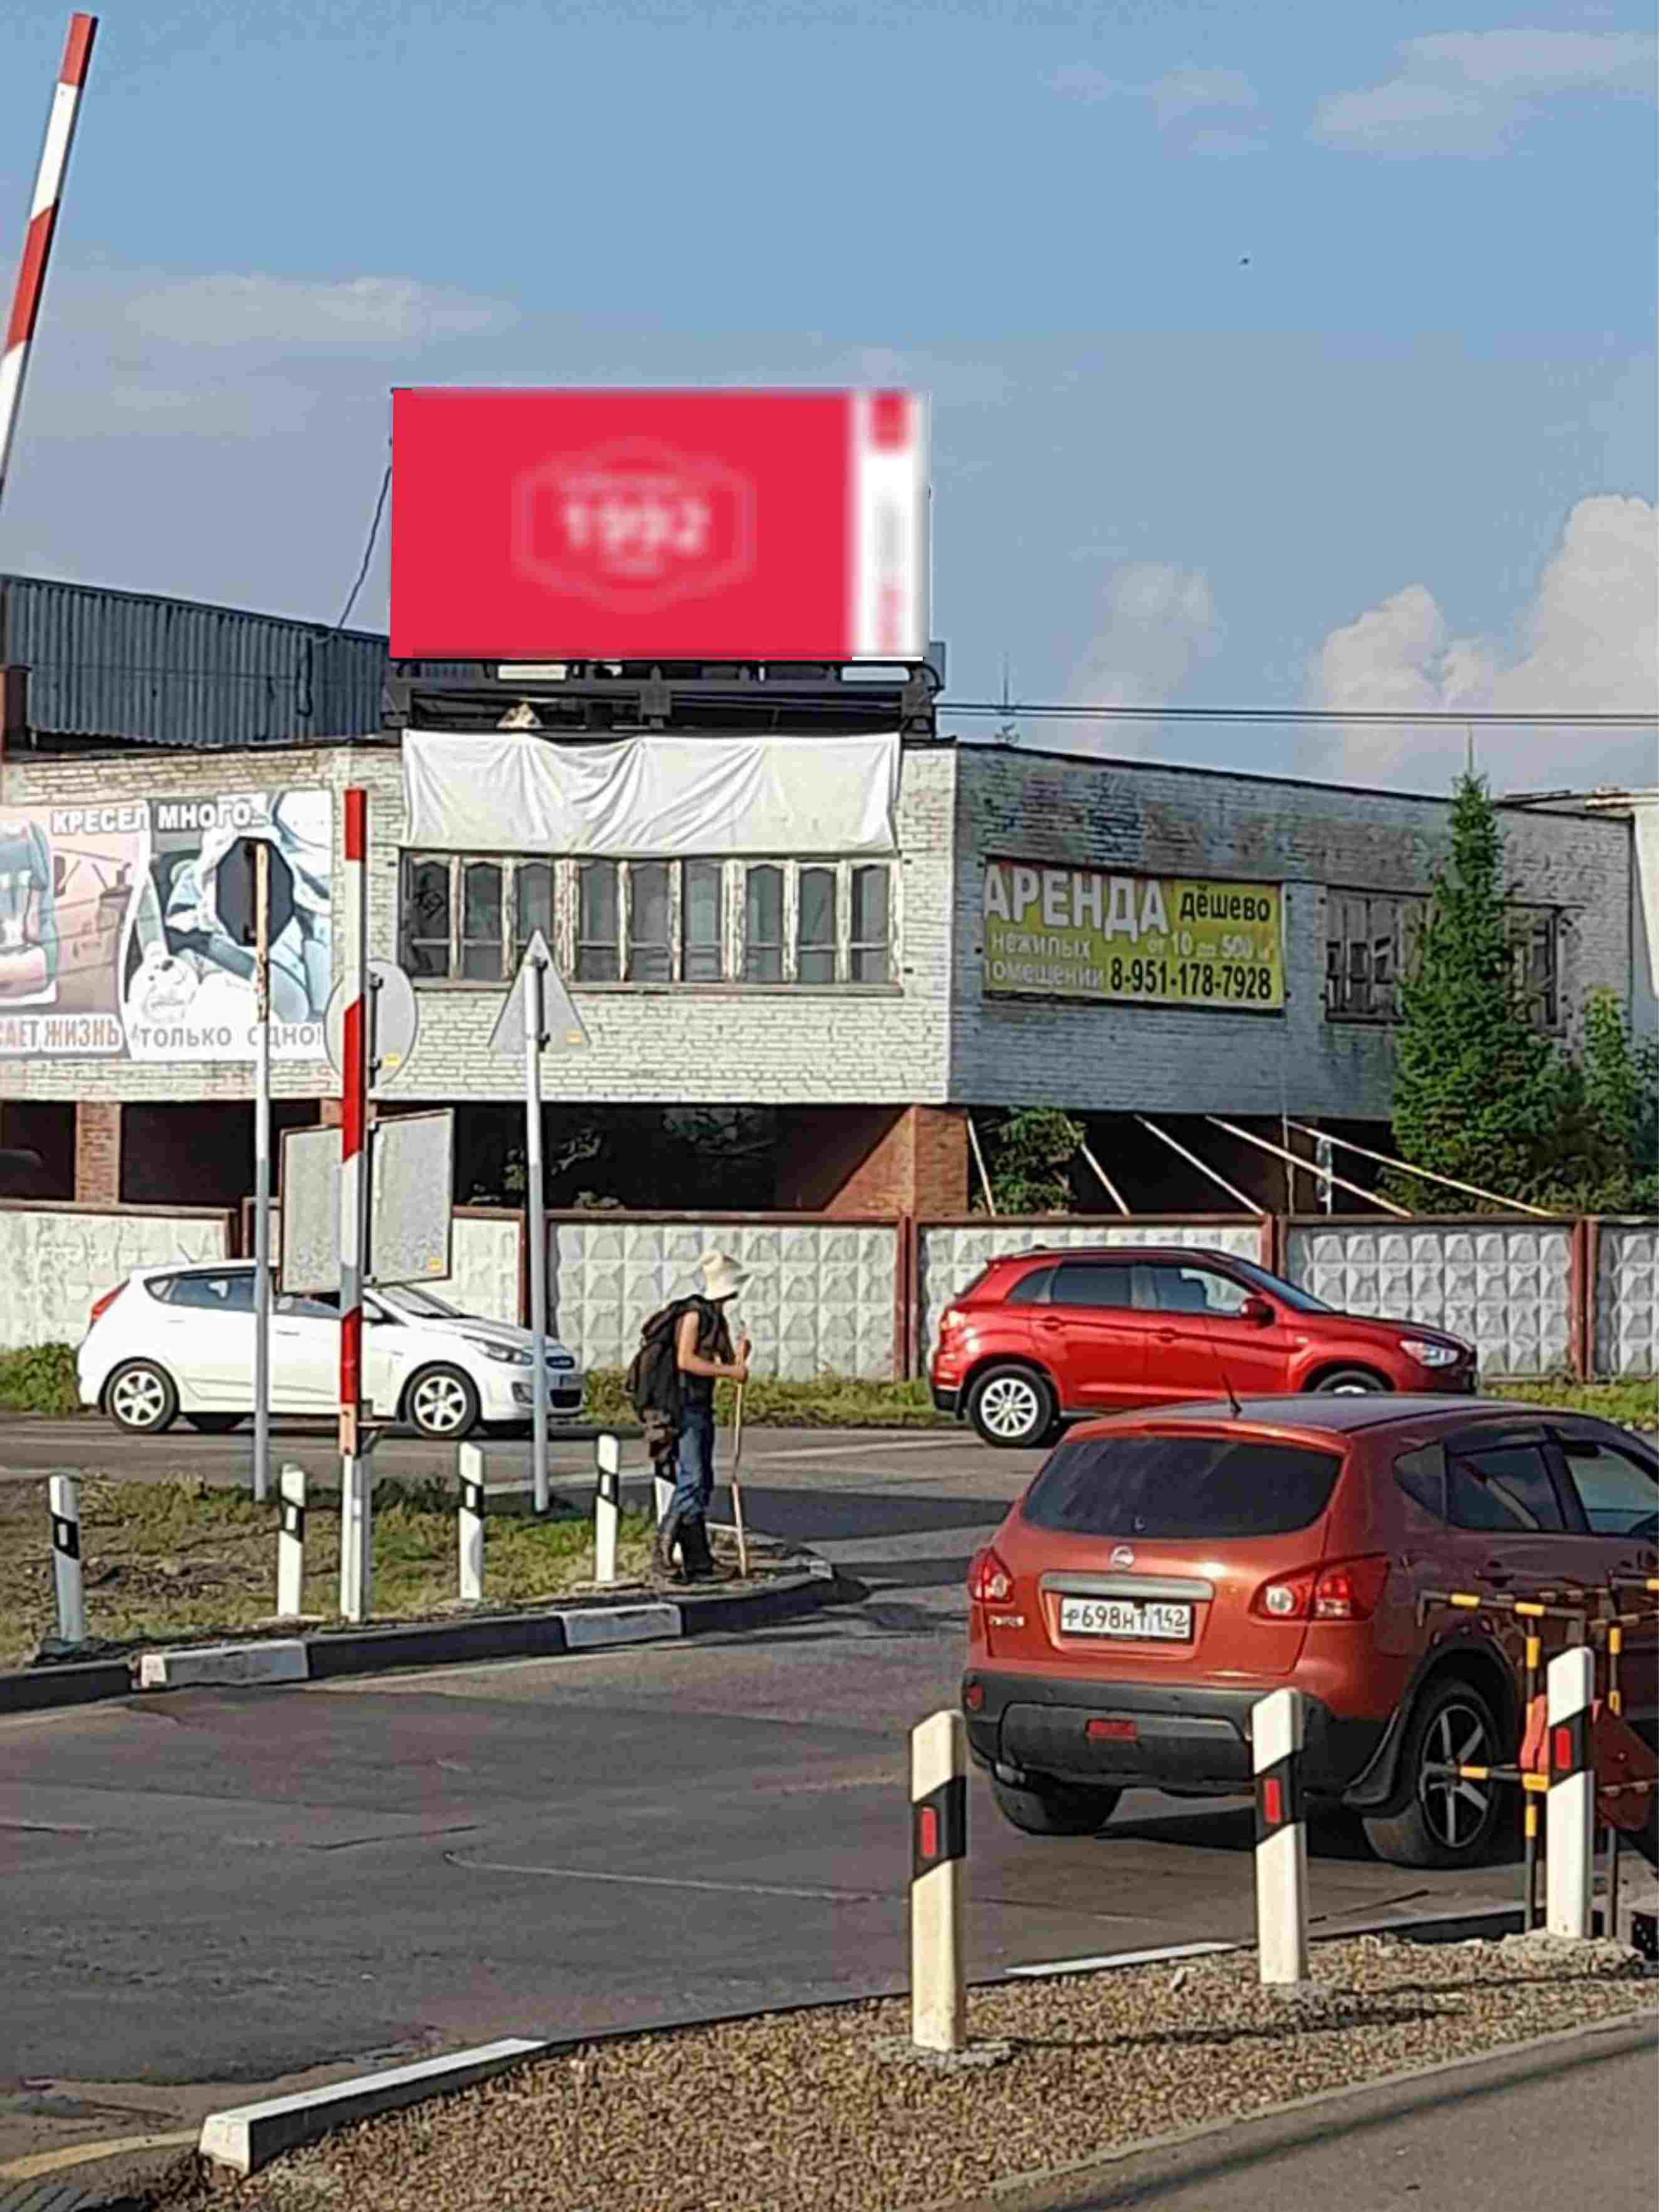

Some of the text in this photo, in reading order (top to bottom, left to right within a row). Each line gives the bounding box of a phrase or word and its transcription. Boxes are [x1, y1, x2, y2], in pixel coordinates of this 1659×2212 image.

[52, 805, 149, 833] КРЕСЕЛ
[983, 863, 1169, 942] АРЕНДА
[1179, 884, 1271, 922] дёшево
[1170, 931, 1194, 956] 10
[1110, 957, 1272, 1000] 8-951-178-7928
[44, 1019, 120, 1047] ЖИЗНЬ
